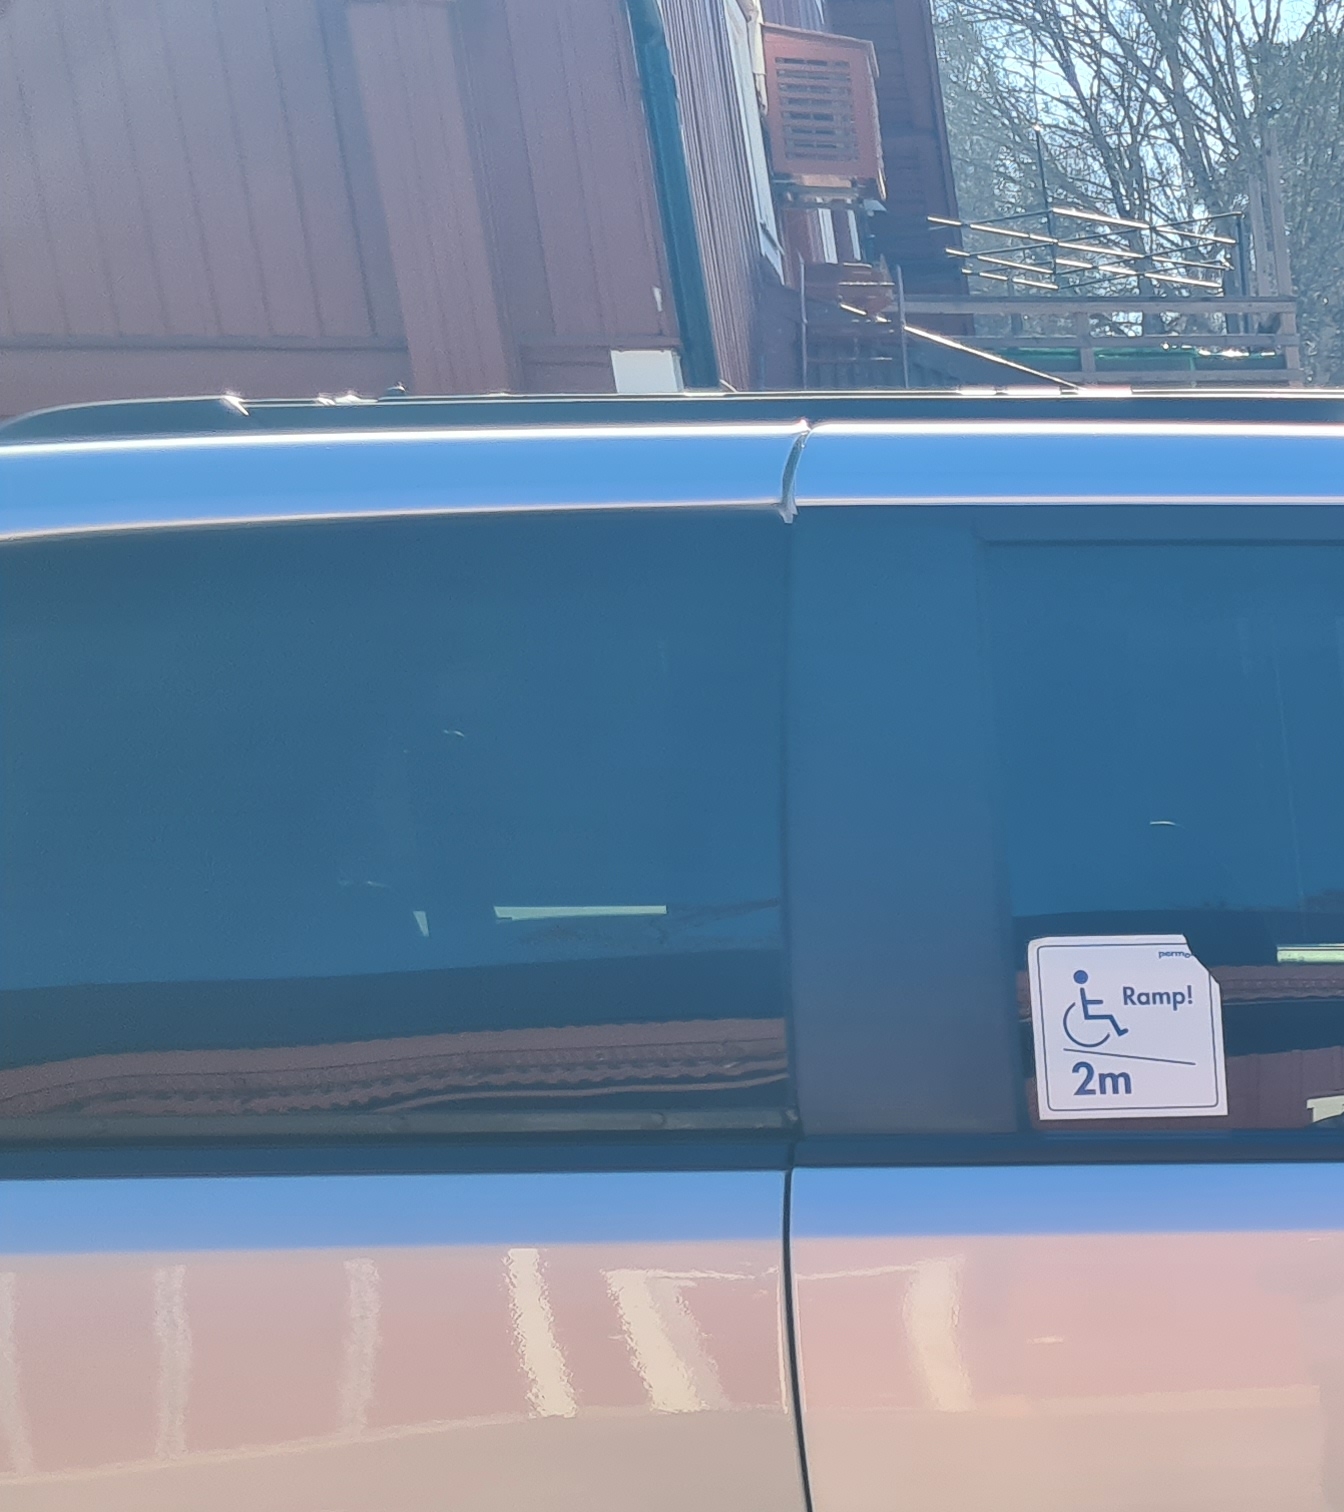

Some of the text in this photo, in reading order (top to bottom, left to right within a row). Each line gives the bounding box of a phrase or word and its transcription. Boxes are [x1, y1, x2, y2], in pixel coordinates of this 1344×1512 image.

[1158, 950, 1193, 959] permo
[1122, 985, 1193, 1011] Ramp!
[1071, 1061, 1132, 1096] 2m
